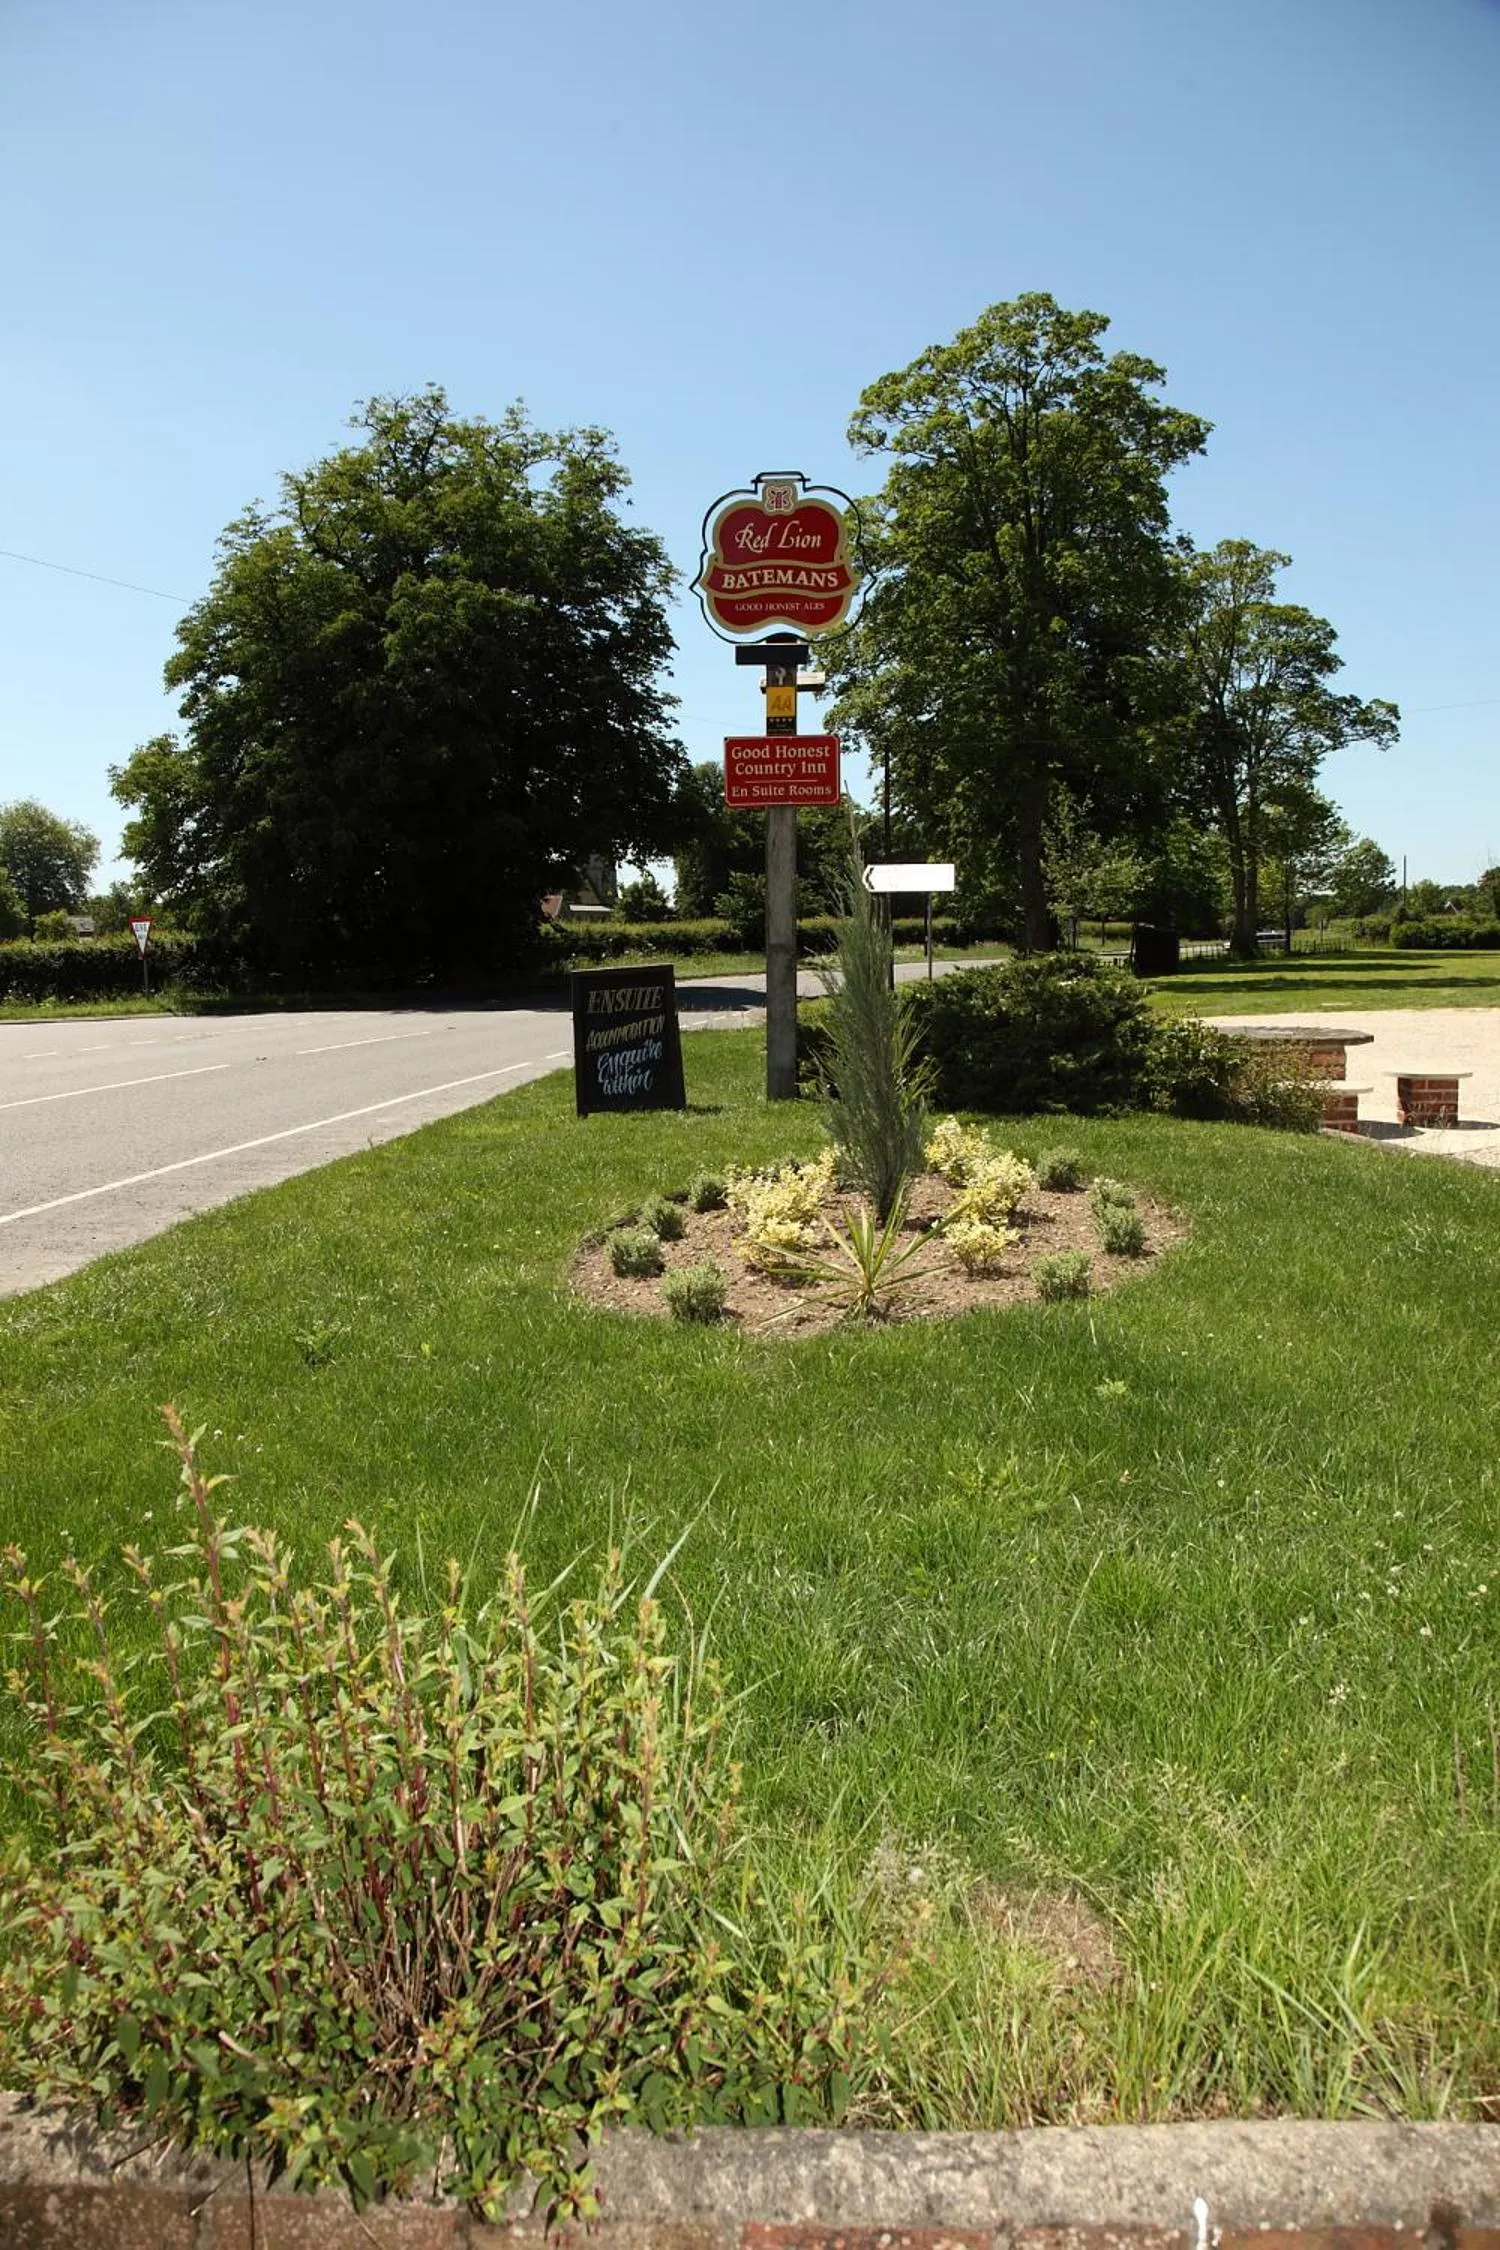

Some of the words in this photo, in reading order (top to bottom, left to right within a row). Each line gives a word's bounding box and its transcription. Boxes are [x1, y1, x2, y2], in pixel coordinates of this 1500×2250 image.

[735, 522, 778, 553] Red
[778, 520, 822, 549] Lion
[722, 569, 838, 589] BATEMANS
[735, 602, 763, 612] GOOD
[765, 602, 801, 612] HONEST
[803, 602, 825, 611] ALES
[771, 695, 793, 711] AA
[731, 745, 770, 759] Good
[776, 745, 830, 758] Honest
[735, 762, 797, 777] Country
[801, 761, 826, 774] Inn
[732, 786, 748, 798] En
[752, 785, 785, 797] Suite
[789, 784, 832, 796] Rooms
[586, 986, 664, 1013] ENSUITE
